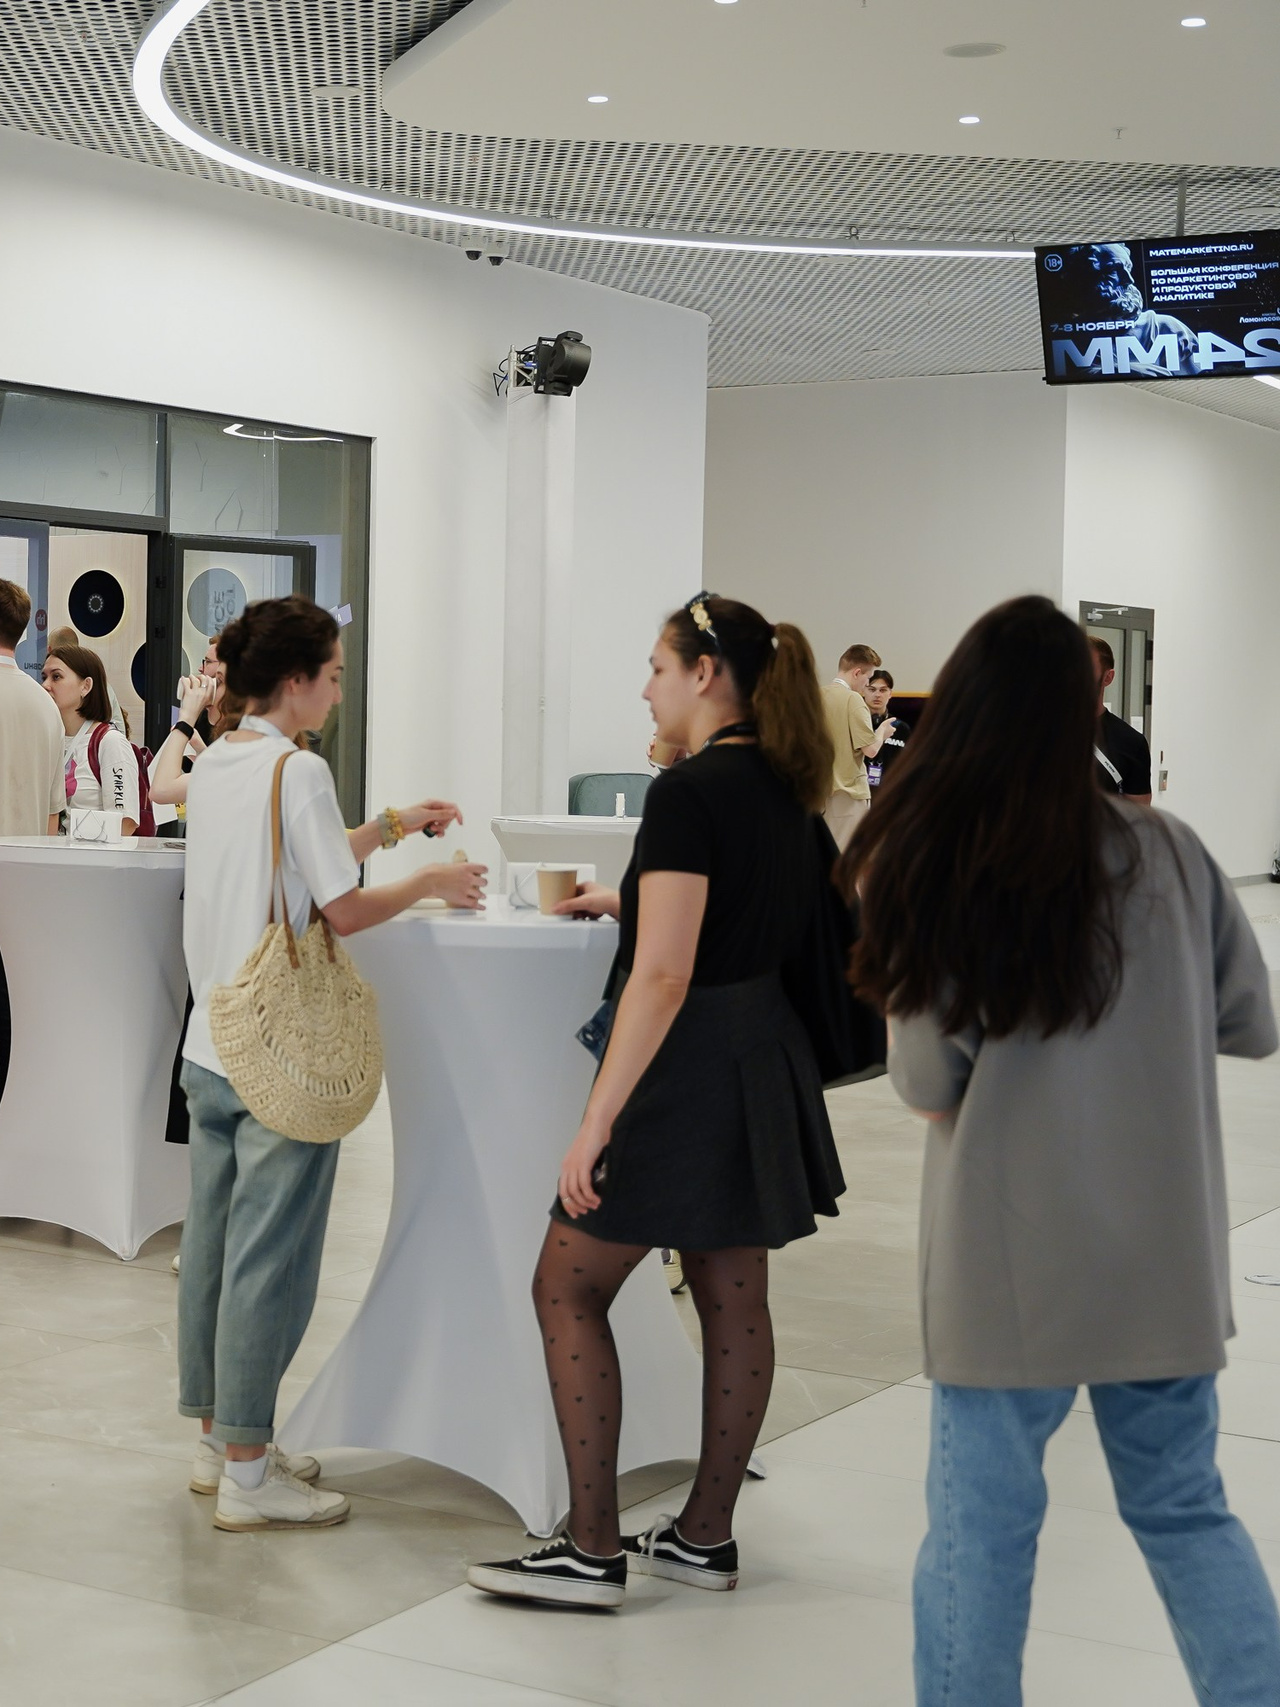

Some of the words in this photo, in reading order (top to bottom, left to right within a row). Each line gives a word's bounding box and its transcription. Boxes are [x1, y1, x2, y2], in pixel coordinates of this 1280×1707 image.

[1048, 259, 1062, 268] 18+
[1151, 266, 1200, 277] БОЛЬШАЯ
[1201, 262, 1279, 274] КОНФЕРЕНЦИЯ
[1167, 271, 1257, 284] МАРКЕТИНГОВОЙ
[1161, 281, 1237, 293] ПРОДУКТОВОЙ
[1153, 292, 1215, 302] АНАЛИТИКЕ
[1050, 323, 1073, 332] 7-8
[1075, 320, 1135, 331] НОЯБРЯ
[112, 767, 124, 810] SPARKLE
